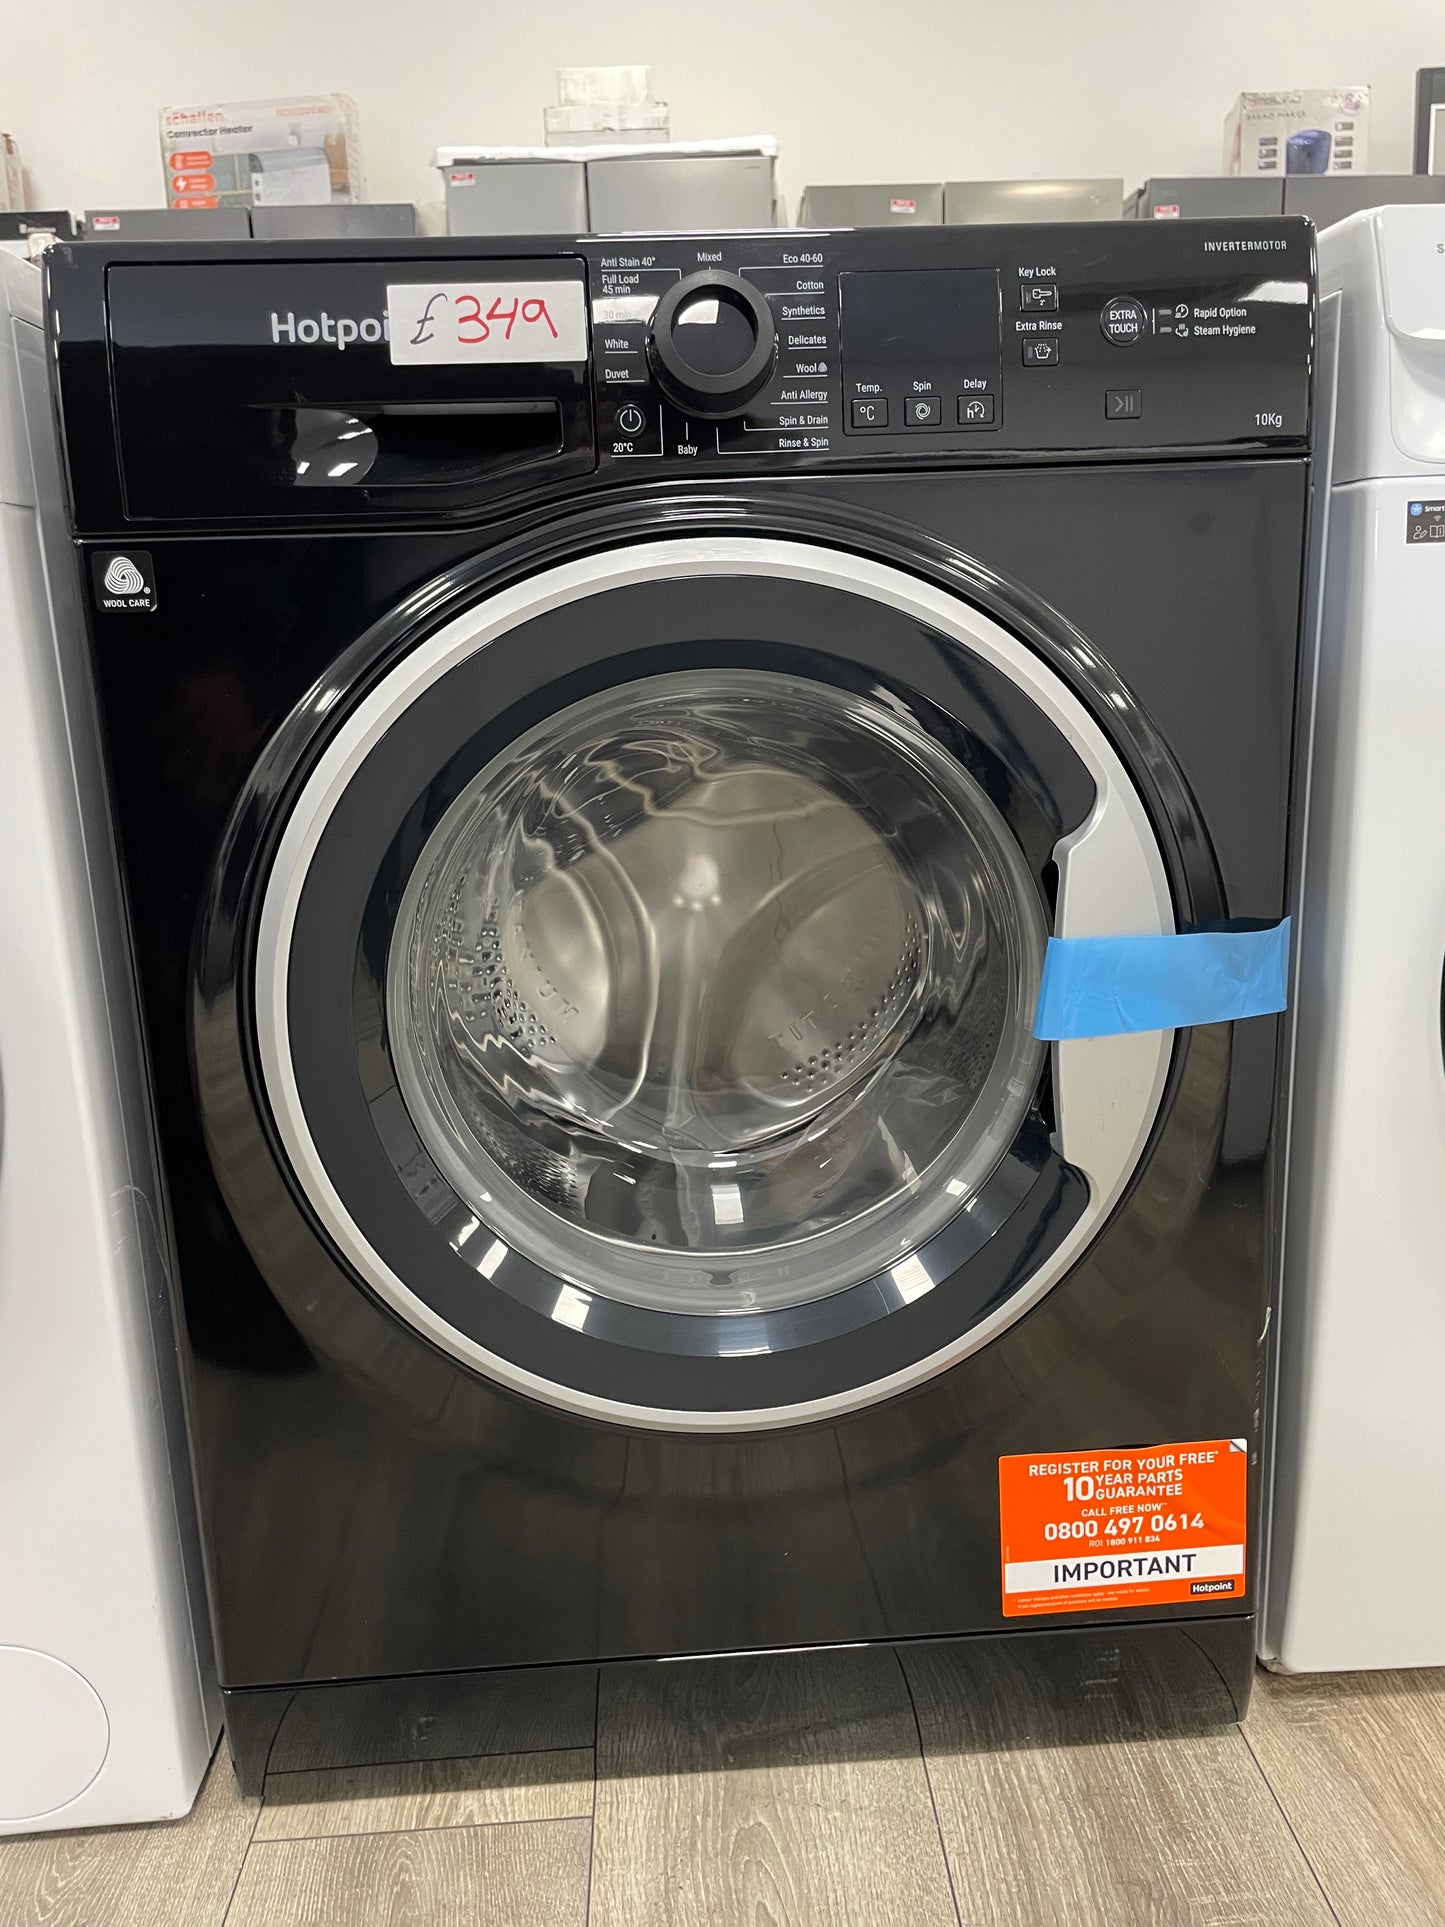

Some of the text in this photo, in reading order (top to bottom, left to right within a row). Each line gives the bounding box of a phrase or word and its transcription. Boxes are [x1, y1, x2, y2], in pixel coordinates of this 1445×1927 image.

[1204, 240, 1287, 252] INVERTERMOTOR
[601, 256, 656, 267] Anti Stain 40°
[697, 252, 722, 262] Mixed
[783, 253, 823, 264] Eco 40-60
[1018, 266, 1056, 278] Key Lock
[602, 274, 640, 284] Full Load
[602, 284, 631, 294] 45 min
[796, 280, 824, 290] Cotton
[782, 306, 826, 317] Synthetics
[1110, 310, 1137, 320] EXTRA
[1194, 307, 1246, 318] Rapid Option
[271, 310, 390, 350] Hotpoi
[1016, 320, 1062, 331] Extra Rinse
[1109, 323, 1138, 334] TOUCH
[1194, 325, 1256, 337] Steam Hygiene
[604, 338, 629, 349] White
[788, 334, 827, 345] Delicates
[605, 368, 629, 379] Duvet
[796, 363, 817, 373] Wool
[856, 383, 883, 394] Temp.
[912, 381, 932, 392] Spin
[964, 379, 987, 390] Delay
[781, 390, 828, 401] Anti Allergy
[779, 415, 828, 427] Spin & Drain
[1255, 413, 1282, 428] 10Kg
[613, 442, 634, 452] 20°C
[779, 438, 829, 449] Rinse & Spin
[678, 445, 698, 456] Baby
[128, 599, 151, 607] CARE
[1028, 1461, 1099, 1476] REGISTER
[1104, 1459, 1132, 1472] FOR
[1136, 1455, 1175, 1470] YOUR
[1063, 1469, 1183, 1502] 10 YEAR PARTS
[1096, 1483, 1182, 1500] GUARANTEE
[1081, 1508, 1107, 1518] CALL
[1110, 1505, 1134, 1515] FREE
[1044, 1512, 1204, 1541] 0800 497 0614
[1089, 1539, 1103, 1547] ROI
[1106, 1538, 1126, 1546] 1800
[1128, 1537, 1142, 1545] 911
[1054, 1553, 1197, 1583] IMPORTANT
[1192, 1581, 1233, 1593] Hotpoint
